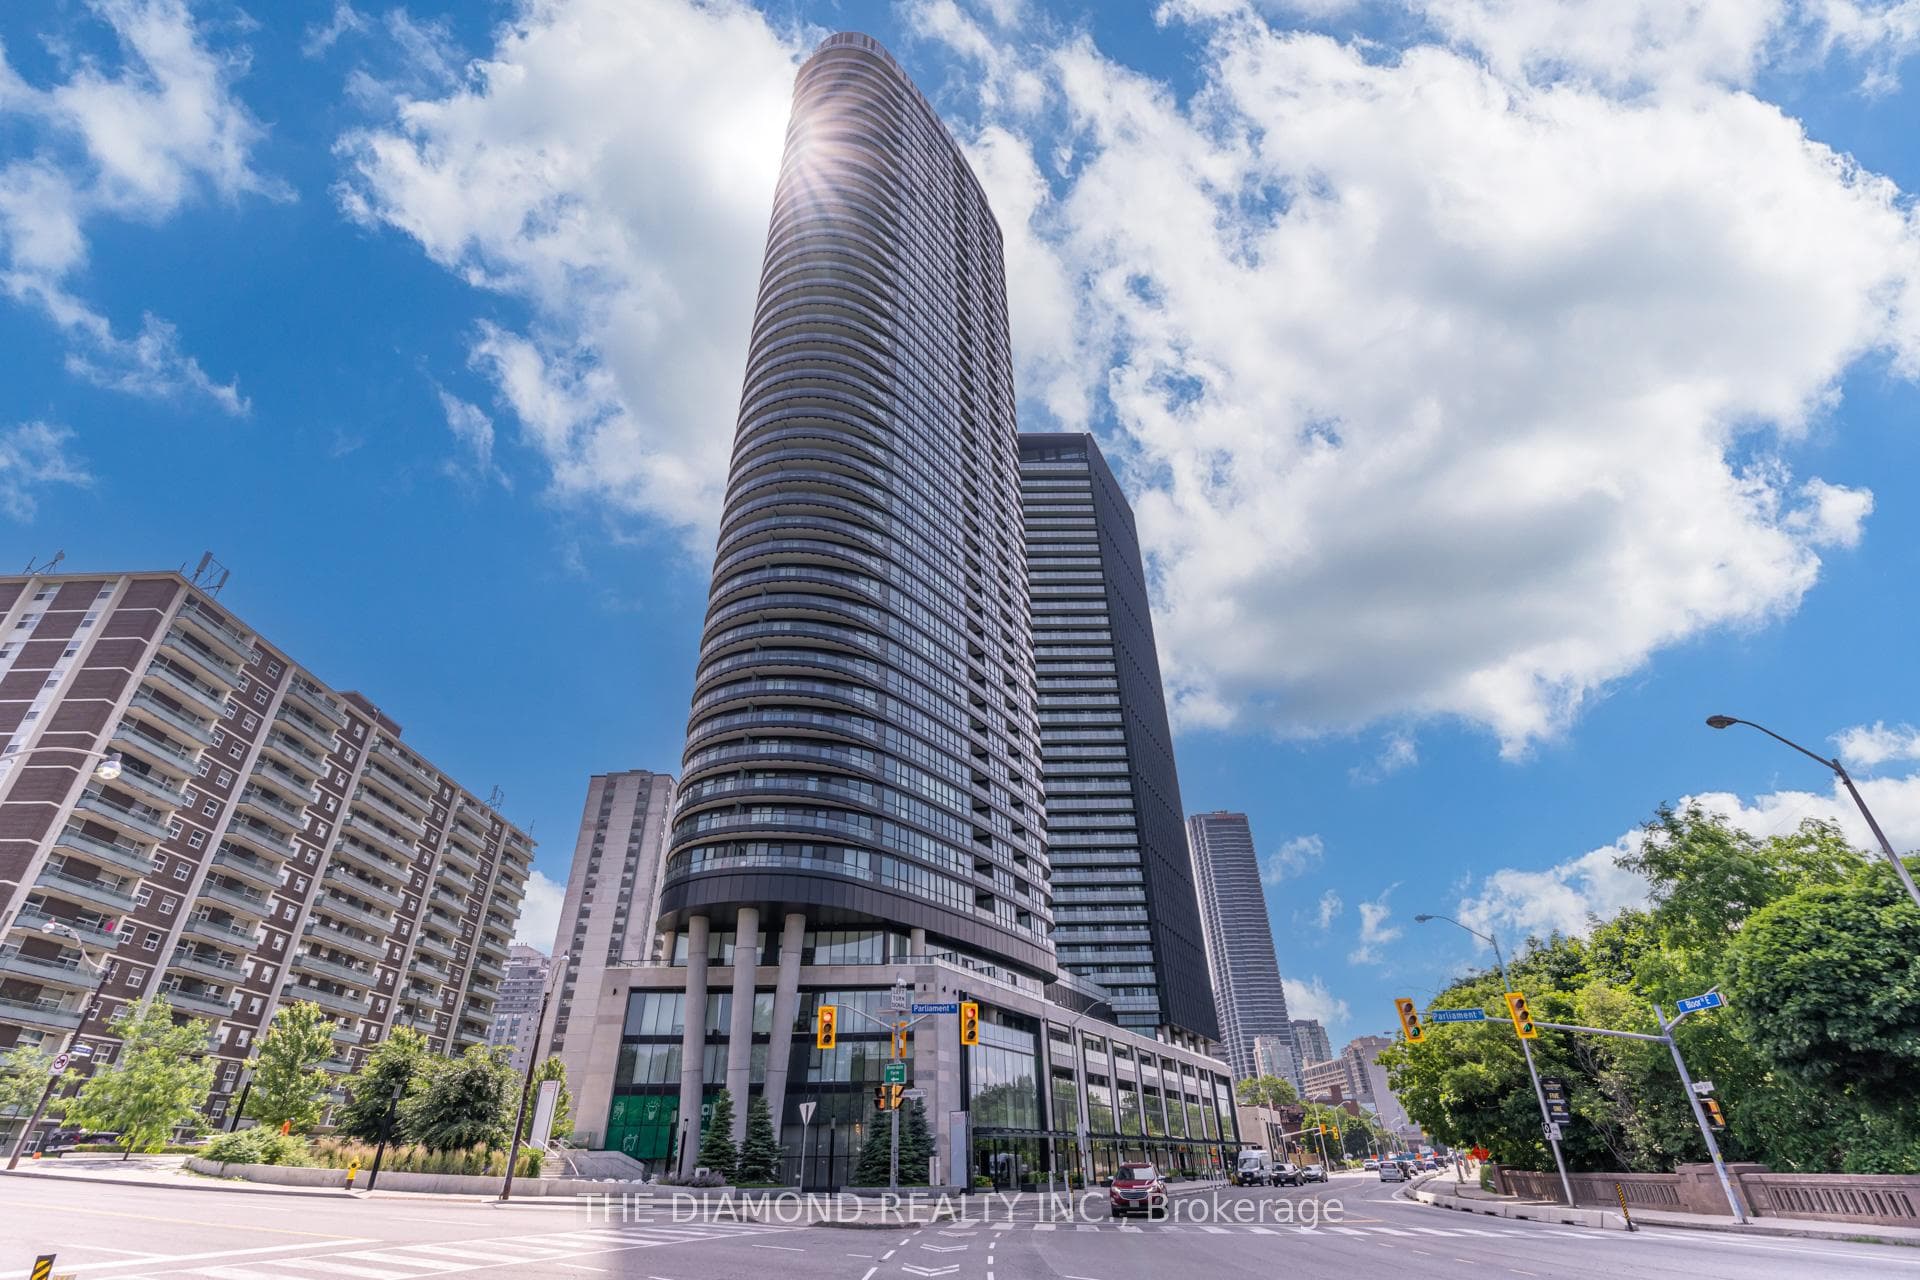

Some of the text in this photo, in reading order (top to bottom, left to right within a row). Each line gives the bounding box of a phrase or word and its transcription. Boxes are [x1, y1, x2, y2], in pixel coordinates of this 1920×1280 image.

[1685, 999, 1702, 1009] Bloor
[1704, 996, 1711, 1005] E
[913, 1004, 950, 1013] Parliament
[1432, 1011, 1478, 1021] Parliament
